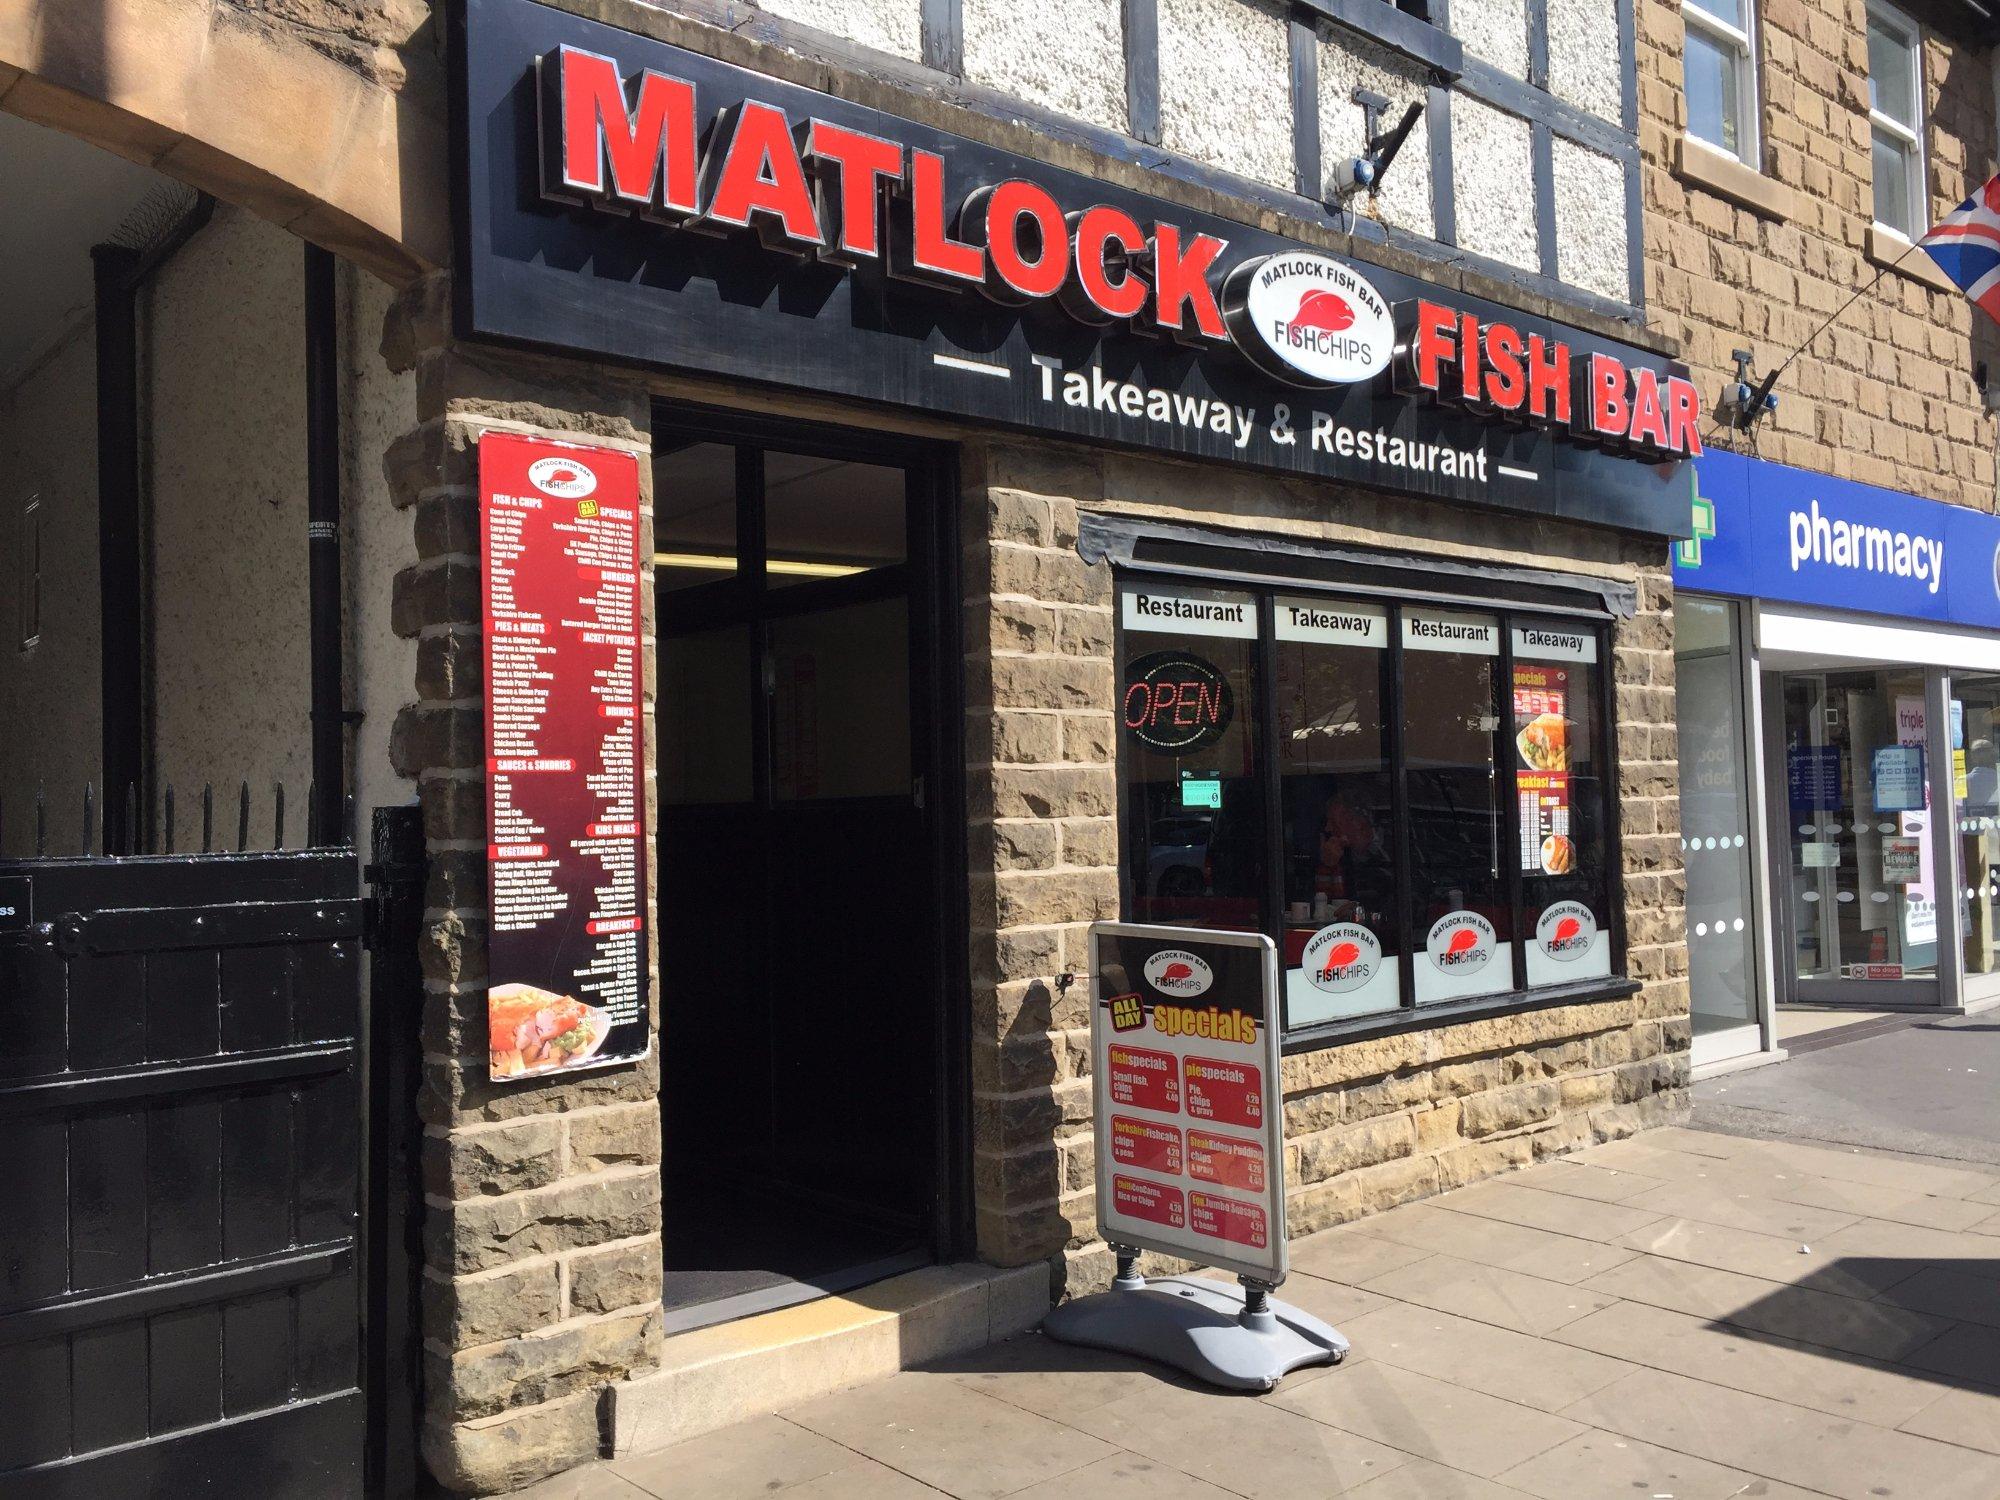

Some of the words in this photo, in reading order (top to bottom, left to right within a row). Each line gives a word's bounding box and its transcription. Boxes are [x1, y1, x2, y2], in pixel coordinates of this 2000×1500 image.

[560, 43, 1230, 341] MATLOCK
[1416, 298, 1570, 424] FISH
[1592, 351, 1704, 457] BAR
[1261, 261, 1323, 289] MATLOCK
[1327, 267, 1355, 292] FISH
[1358, 286, 1383, 320] BAR
[1031, 353, 1256, 449] Takeaway
[1270, 402, 1296, 446] &
[1311, 413, 1488, 483] Restaurant
[493, 493, 511, 505] FISH
[519, 496, 542, 509] CHIPS
[600, 507, 632, 520] SPECIALS
[1789, 499, 1943, 594] pharmacy
[1136, 594, 1243, 623] Restaurant
[495, 621, 512, 632] PIES
[520, 622, 545, 634] MEATS
[1289, 607, 1372, 637] Takeaway
[1411, 618, 1490, 642] Restaurant
[1521, 628, 1584, 653] Takeaway
[1124, 681, 1222, 727] OPEN
[1900, 710, 1924, 731] triple
[497, 760, 527, 771] SAUCES
[1541, 907, 1566, 927] MATLOCK
[1567, 906, 1580, 914] FISH
[1432, 917, 1461, 940] MATLOCK
[1463, 916, 1477, 925] FISH
[1478, 920, 1491, 935] BAR
[1308, 929, 1342, 955] MATLOCK
[1343, 929, 1359, 938] FISH
[1360, 932, 1375, 948] BAR
[1150, 952, 1179, 966] MATLOCK
[1179, 952, 1194, 962] FISH
[1194, 958, 1208, 972] BAR
[1113, 998, 1139, 1015] ALL
[1114, 1010, 1141, 1028] DAY
[1154, 1004, 1257, 1044] specials
[1113, 1070, 1132, 1083] Small
[1113, 1081, 1133, 1094] chips
[1189, 1095, 1211, 1108] chips
[1114, 1135, 1135, 1148] chips
[1190, 1151, 1212, 1164] chips
[1193, 1208, 1214, 1220] chips
